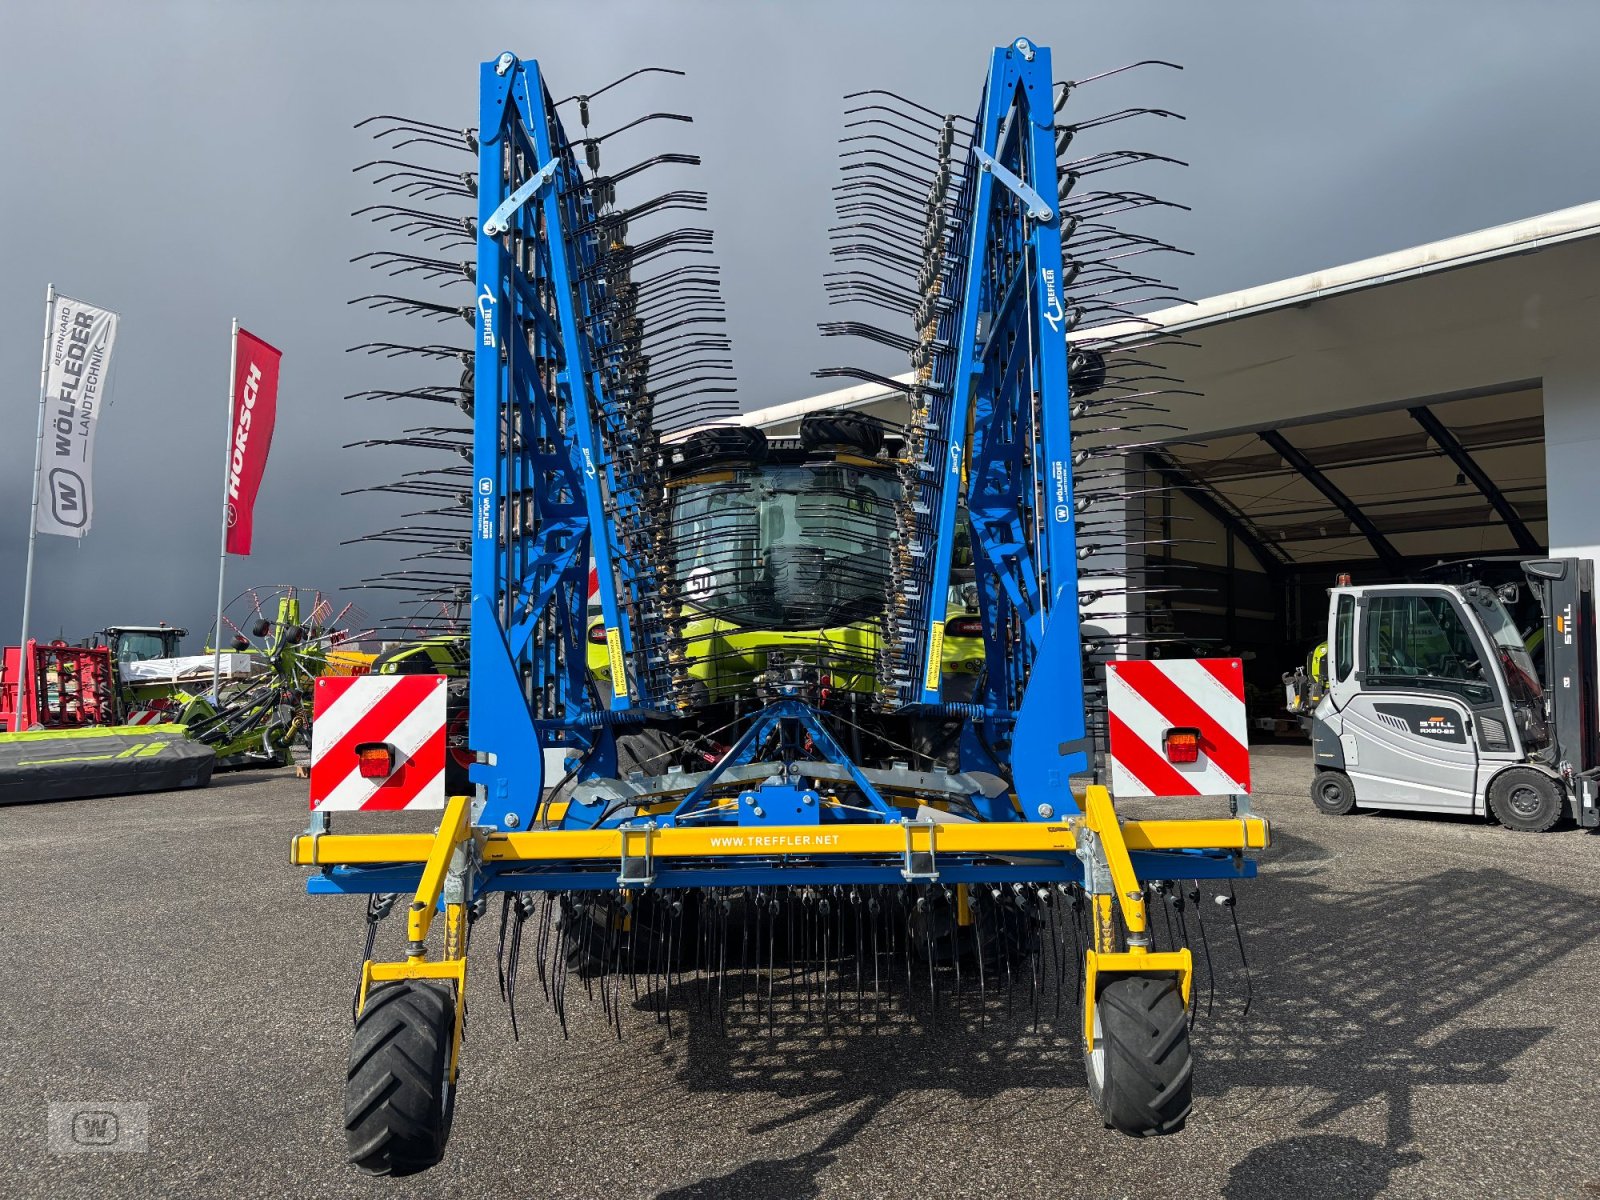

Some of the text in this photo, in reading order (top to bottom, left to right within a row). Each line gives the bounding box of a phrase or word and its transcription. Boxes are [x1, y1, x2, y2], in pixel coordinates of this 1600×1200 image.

[1046, 269, 1056, 307] TREFFLER
[483, 308, 492, 346] TREFFLER
[53, 311, 94, 456] WÖLFLEDER
[78, 344, 104, 437] LANDTECHNIK
[229, 362, 262, 500] HORSCH
[767, 440, 804, 450] CLAA
[61, 481, 78, 511] W
[1563, 603, 1572, 645] STILL
[710, 834, 840, 847] WWW.TREFFLER.NET
